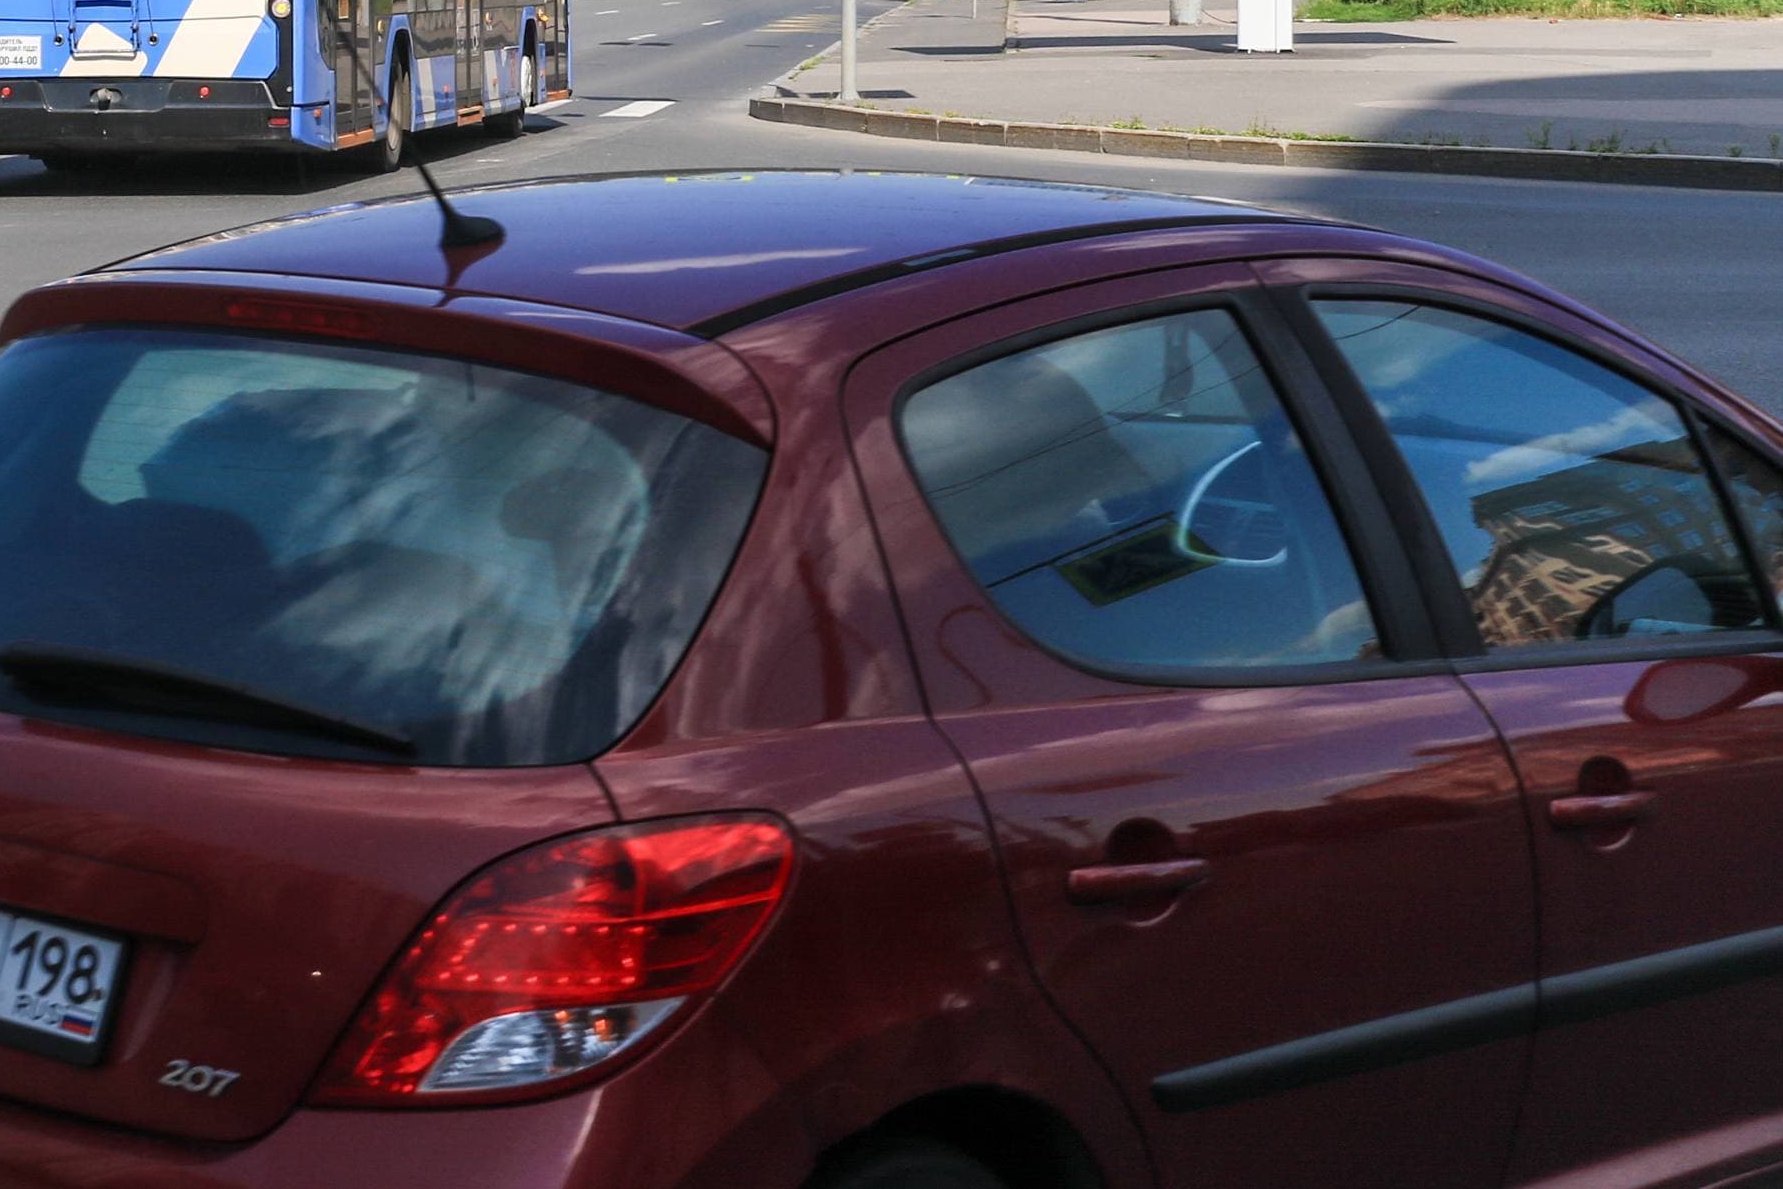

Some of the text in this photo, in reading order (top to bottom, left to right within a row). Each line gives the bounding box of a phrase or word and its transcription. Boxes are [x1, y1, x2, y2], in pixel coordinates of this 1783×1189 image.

[10, 930, 101, 1006] 198
[15, 994, 64, 1027] RUS
[158, 1059, 240, 1097] 207
